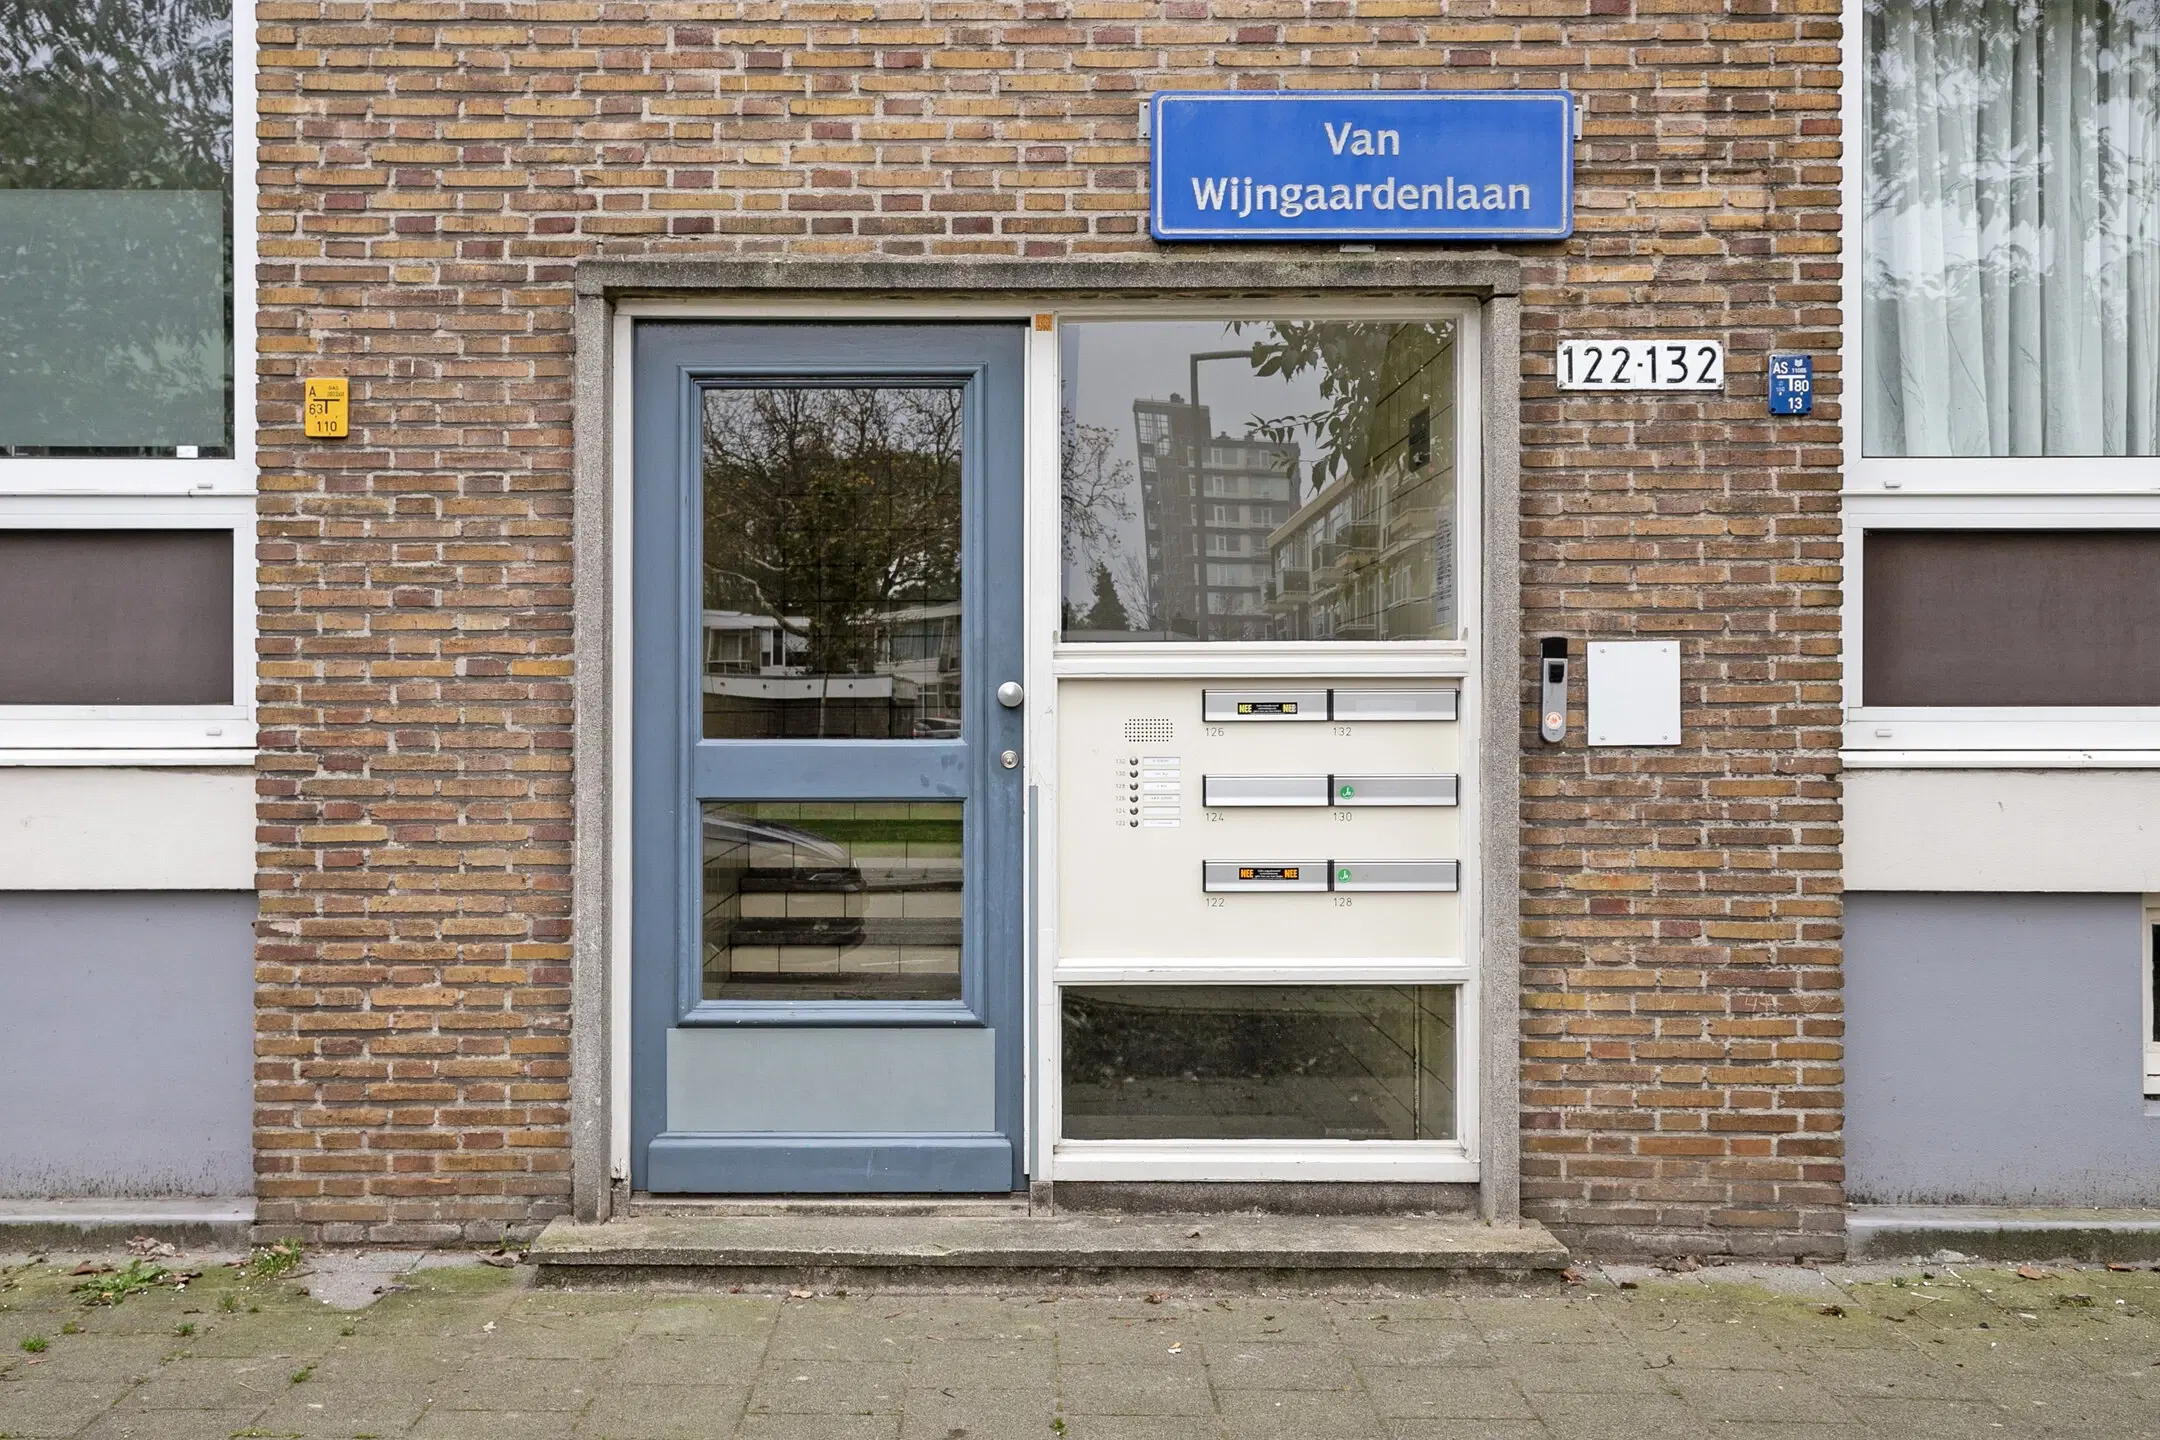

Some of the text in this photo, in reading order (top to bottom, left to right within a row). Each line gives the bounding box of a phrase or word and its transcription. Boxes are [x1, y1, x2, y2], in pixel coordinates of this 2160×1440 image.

[1324, 122, 1400, 157] Van
[1191, 176, 1532, 218] Wijngaardenlaan
[1773, 361, 1788, 374] AS
[309, 386, 316, 397] A
[1794, 380, 1809, 392] 80
[1788, 397, 1803, 409] 13
[309, 404, 323, 415] 63
[317, 421, 337, 432] 110
[1239, 704, 1253, 713] NEE
[1282, 703, 1296, 713] NEE
[1205, 727, 1225, 737] 126
[1332, 726, 1352, 737] 132
[1205, 812, 1225, 822] 124
[1333, 811, 1353, 822] 130
[1240, 869, 1254, 878] NEE
[1284, 869, 1298, 878] NEE
[1205, 897, 1225, 908] 122
[1333, 897, 1353, 908] 128
